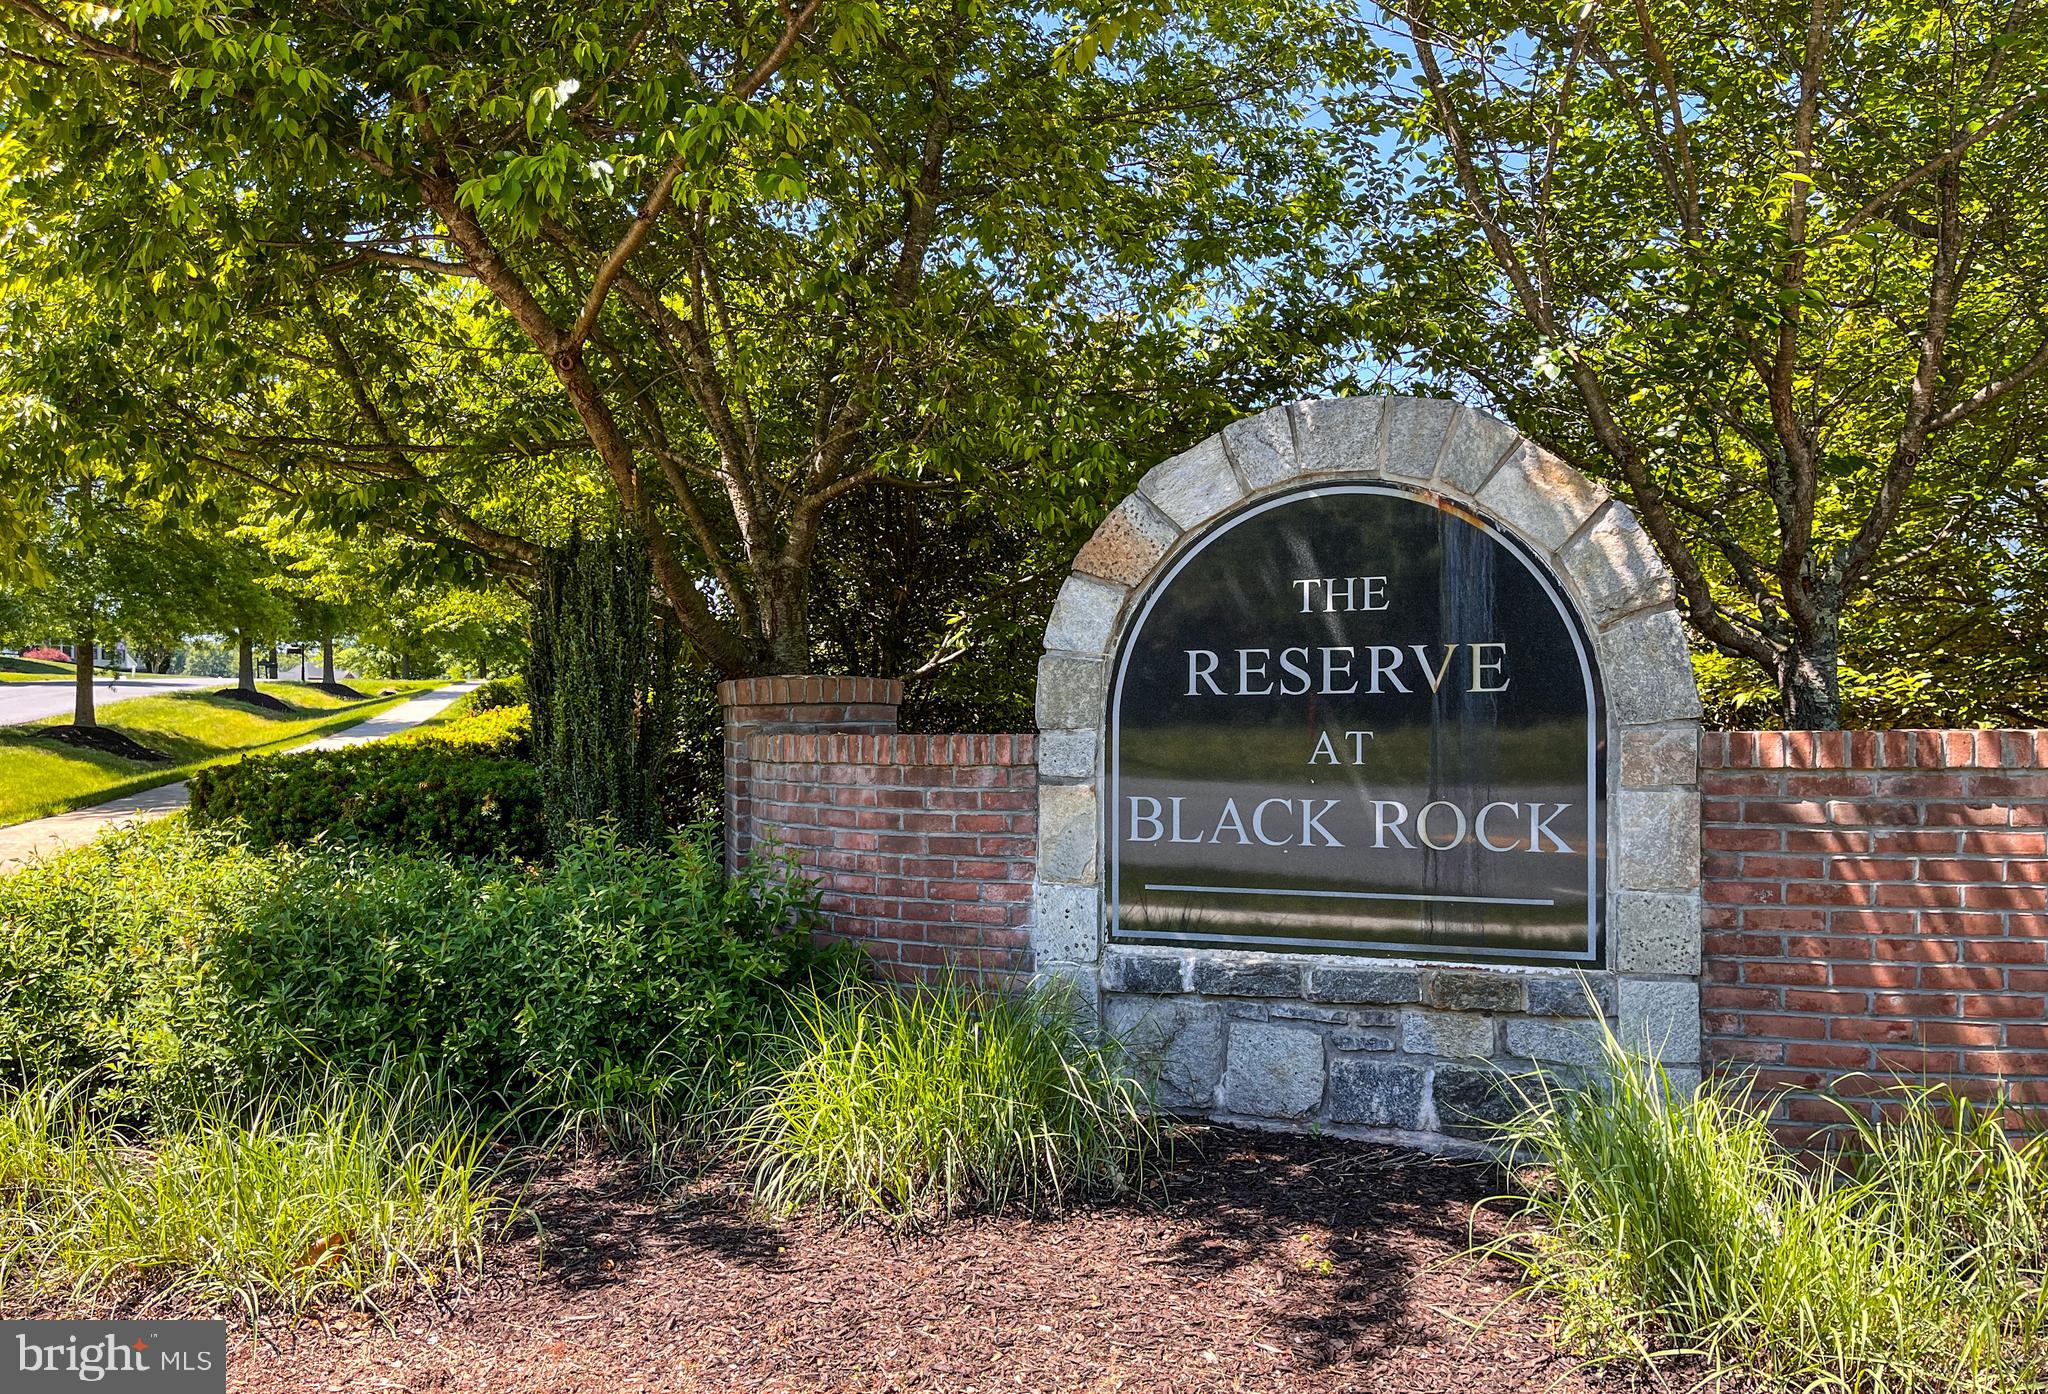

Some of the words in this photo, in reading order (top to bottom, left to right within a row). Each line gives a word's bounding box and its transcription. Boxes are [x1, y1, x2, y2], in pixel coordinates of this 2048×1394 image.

[1293, 576, 1390, 613] THE
[1184, 643, 1511, 696] RESERVE
[1308, 731, 1374, 765] AT
[1126, 796, 1345, 847] BLACK
[1370, 800, 1576, 854] ROCK
